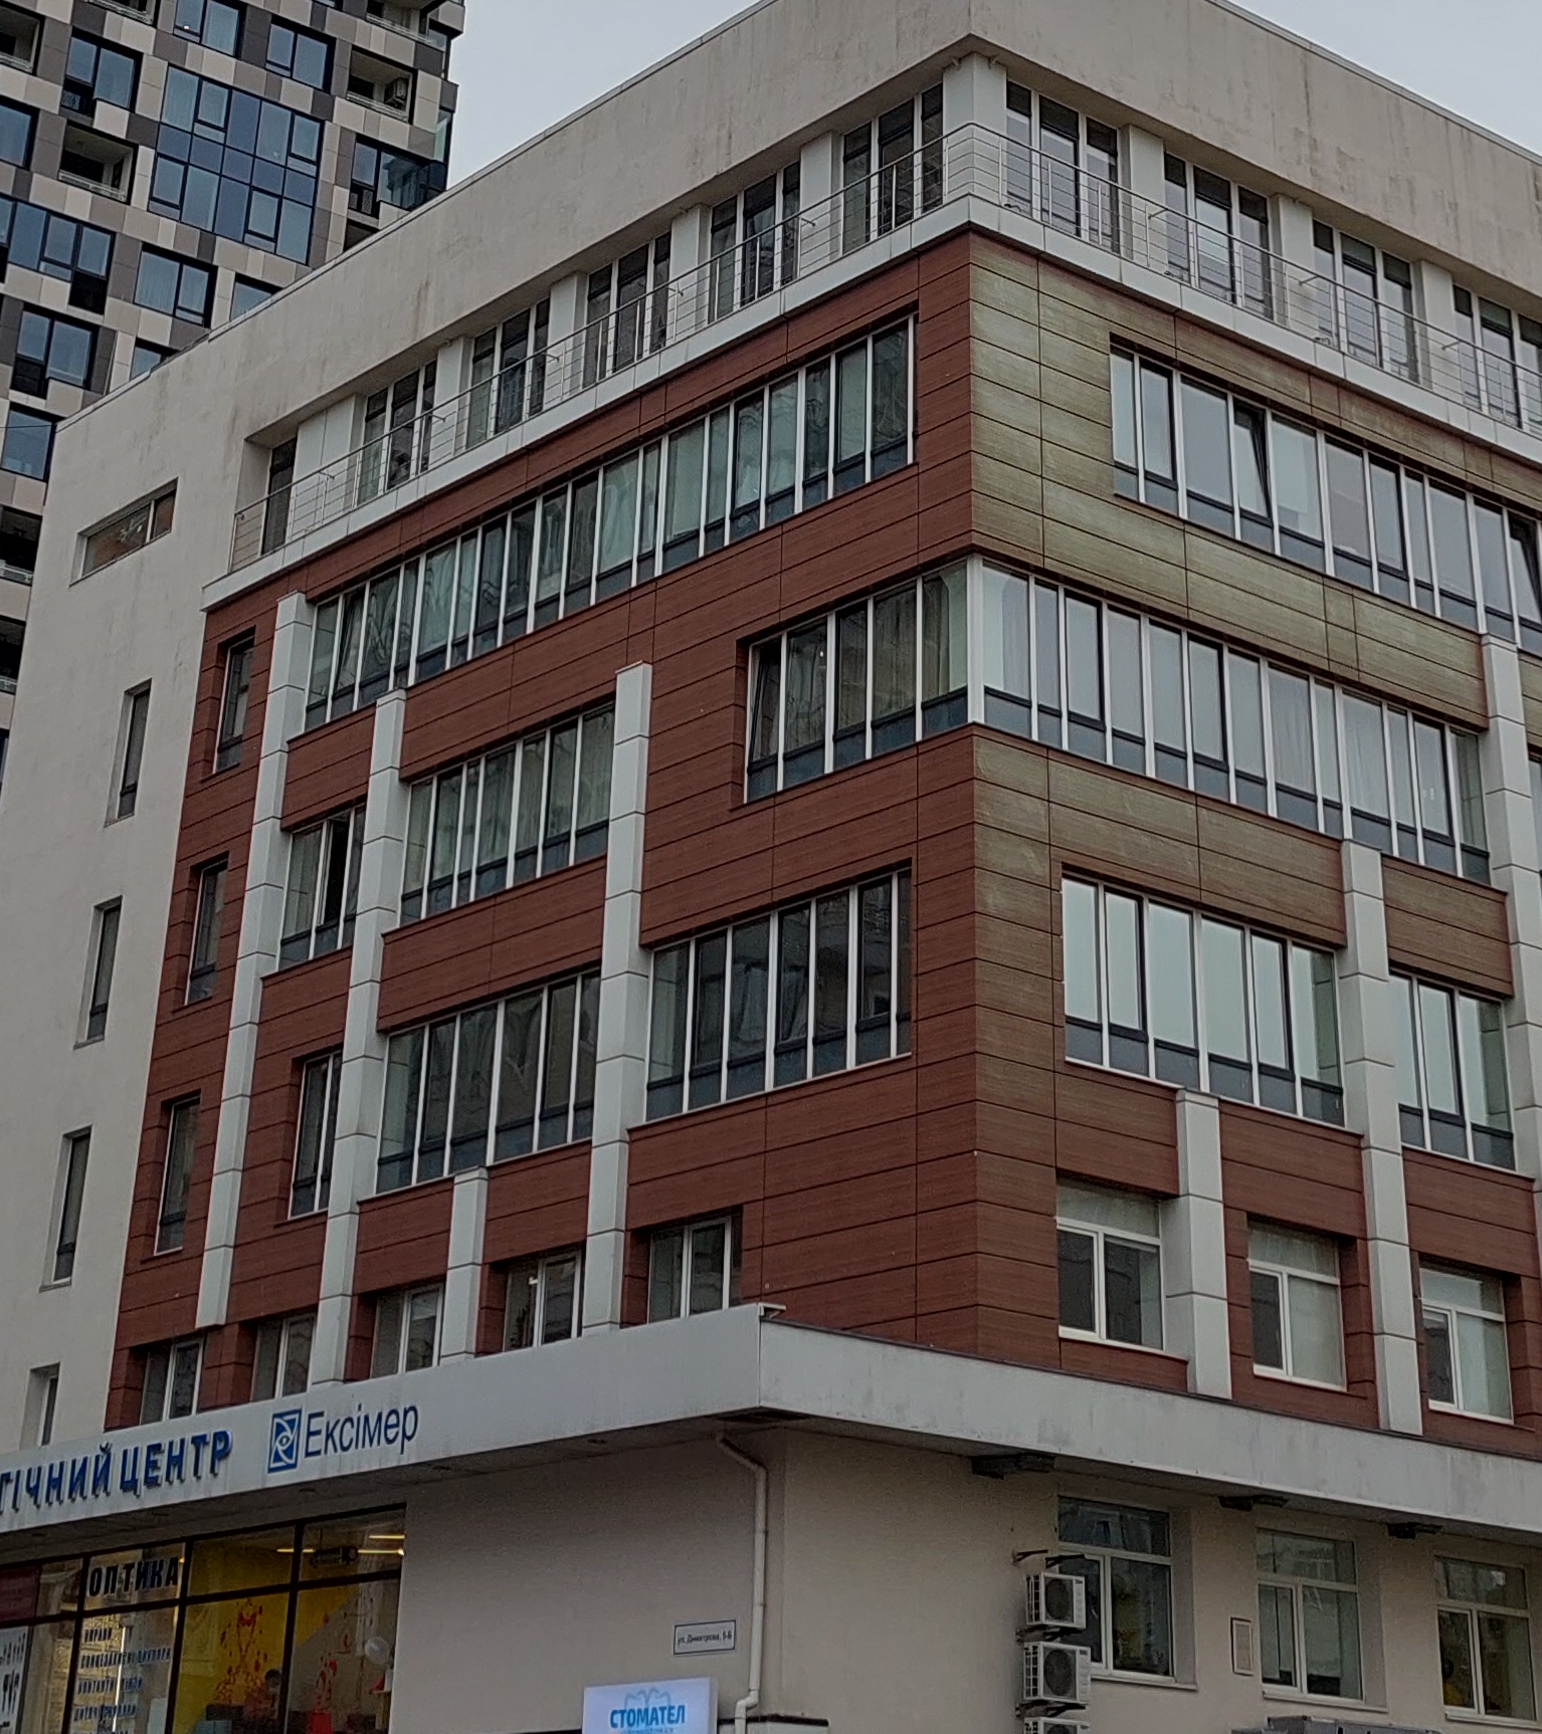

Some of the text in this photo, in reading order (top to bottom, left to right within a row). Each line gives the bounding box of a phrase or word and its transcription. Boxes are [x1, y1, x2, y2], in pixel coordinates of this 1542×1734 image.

[304, 1403, 419, 1455] Ексімер
[119, 1430, 233, 1498] ЦЕНТР
[89, 1557, 178, 1596] ОПТИКА
[610, 1704, 685, 1729] СТОМАТЕЛ
